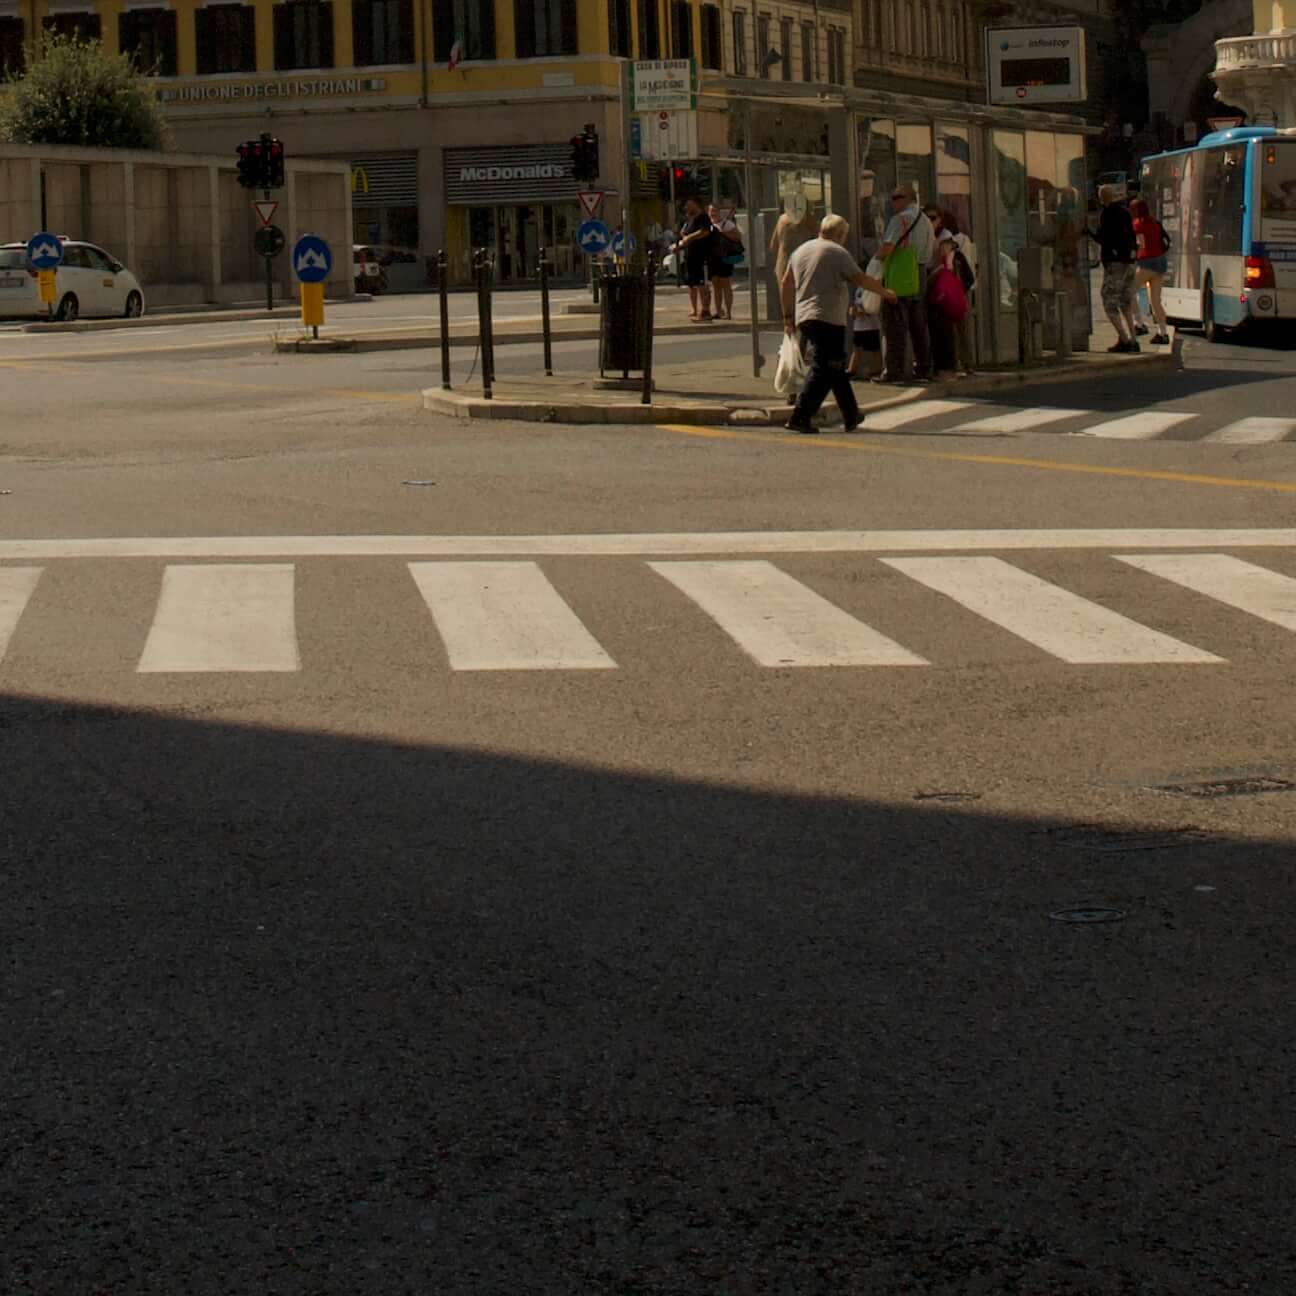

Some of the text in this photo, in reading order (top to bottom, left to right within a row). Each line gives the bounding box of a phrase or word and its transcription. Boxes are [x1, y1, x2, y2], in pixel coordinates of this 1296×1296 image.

[179, 79, 361, 101] UNIONE DEGLI ISTRIANI
[460, 164, 564, 181] McDonald's
